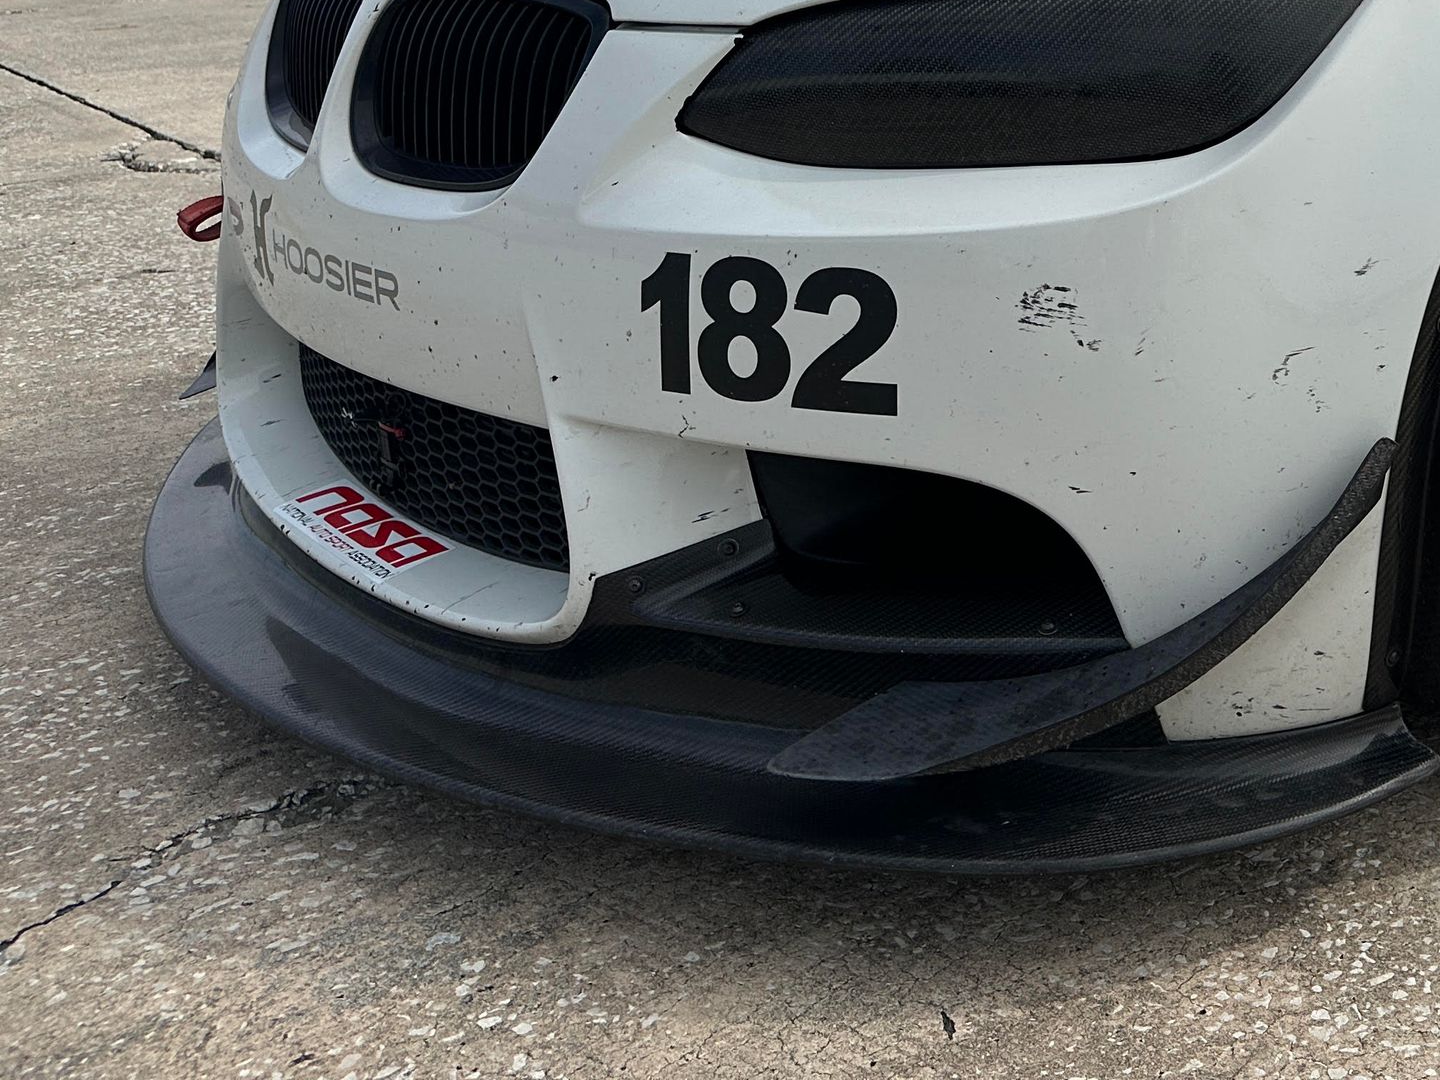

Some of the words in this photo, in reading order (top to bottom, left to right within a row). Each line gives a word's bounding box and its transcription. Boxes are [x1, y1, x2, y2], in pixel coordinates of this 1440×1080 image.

[272, 227, 400, 311] HOOSIER
[641, 252, 898, 417] 182
[282, 503, 313, 527] NATIONAL
[347, 550, 391, 579] ASSOCIATION
